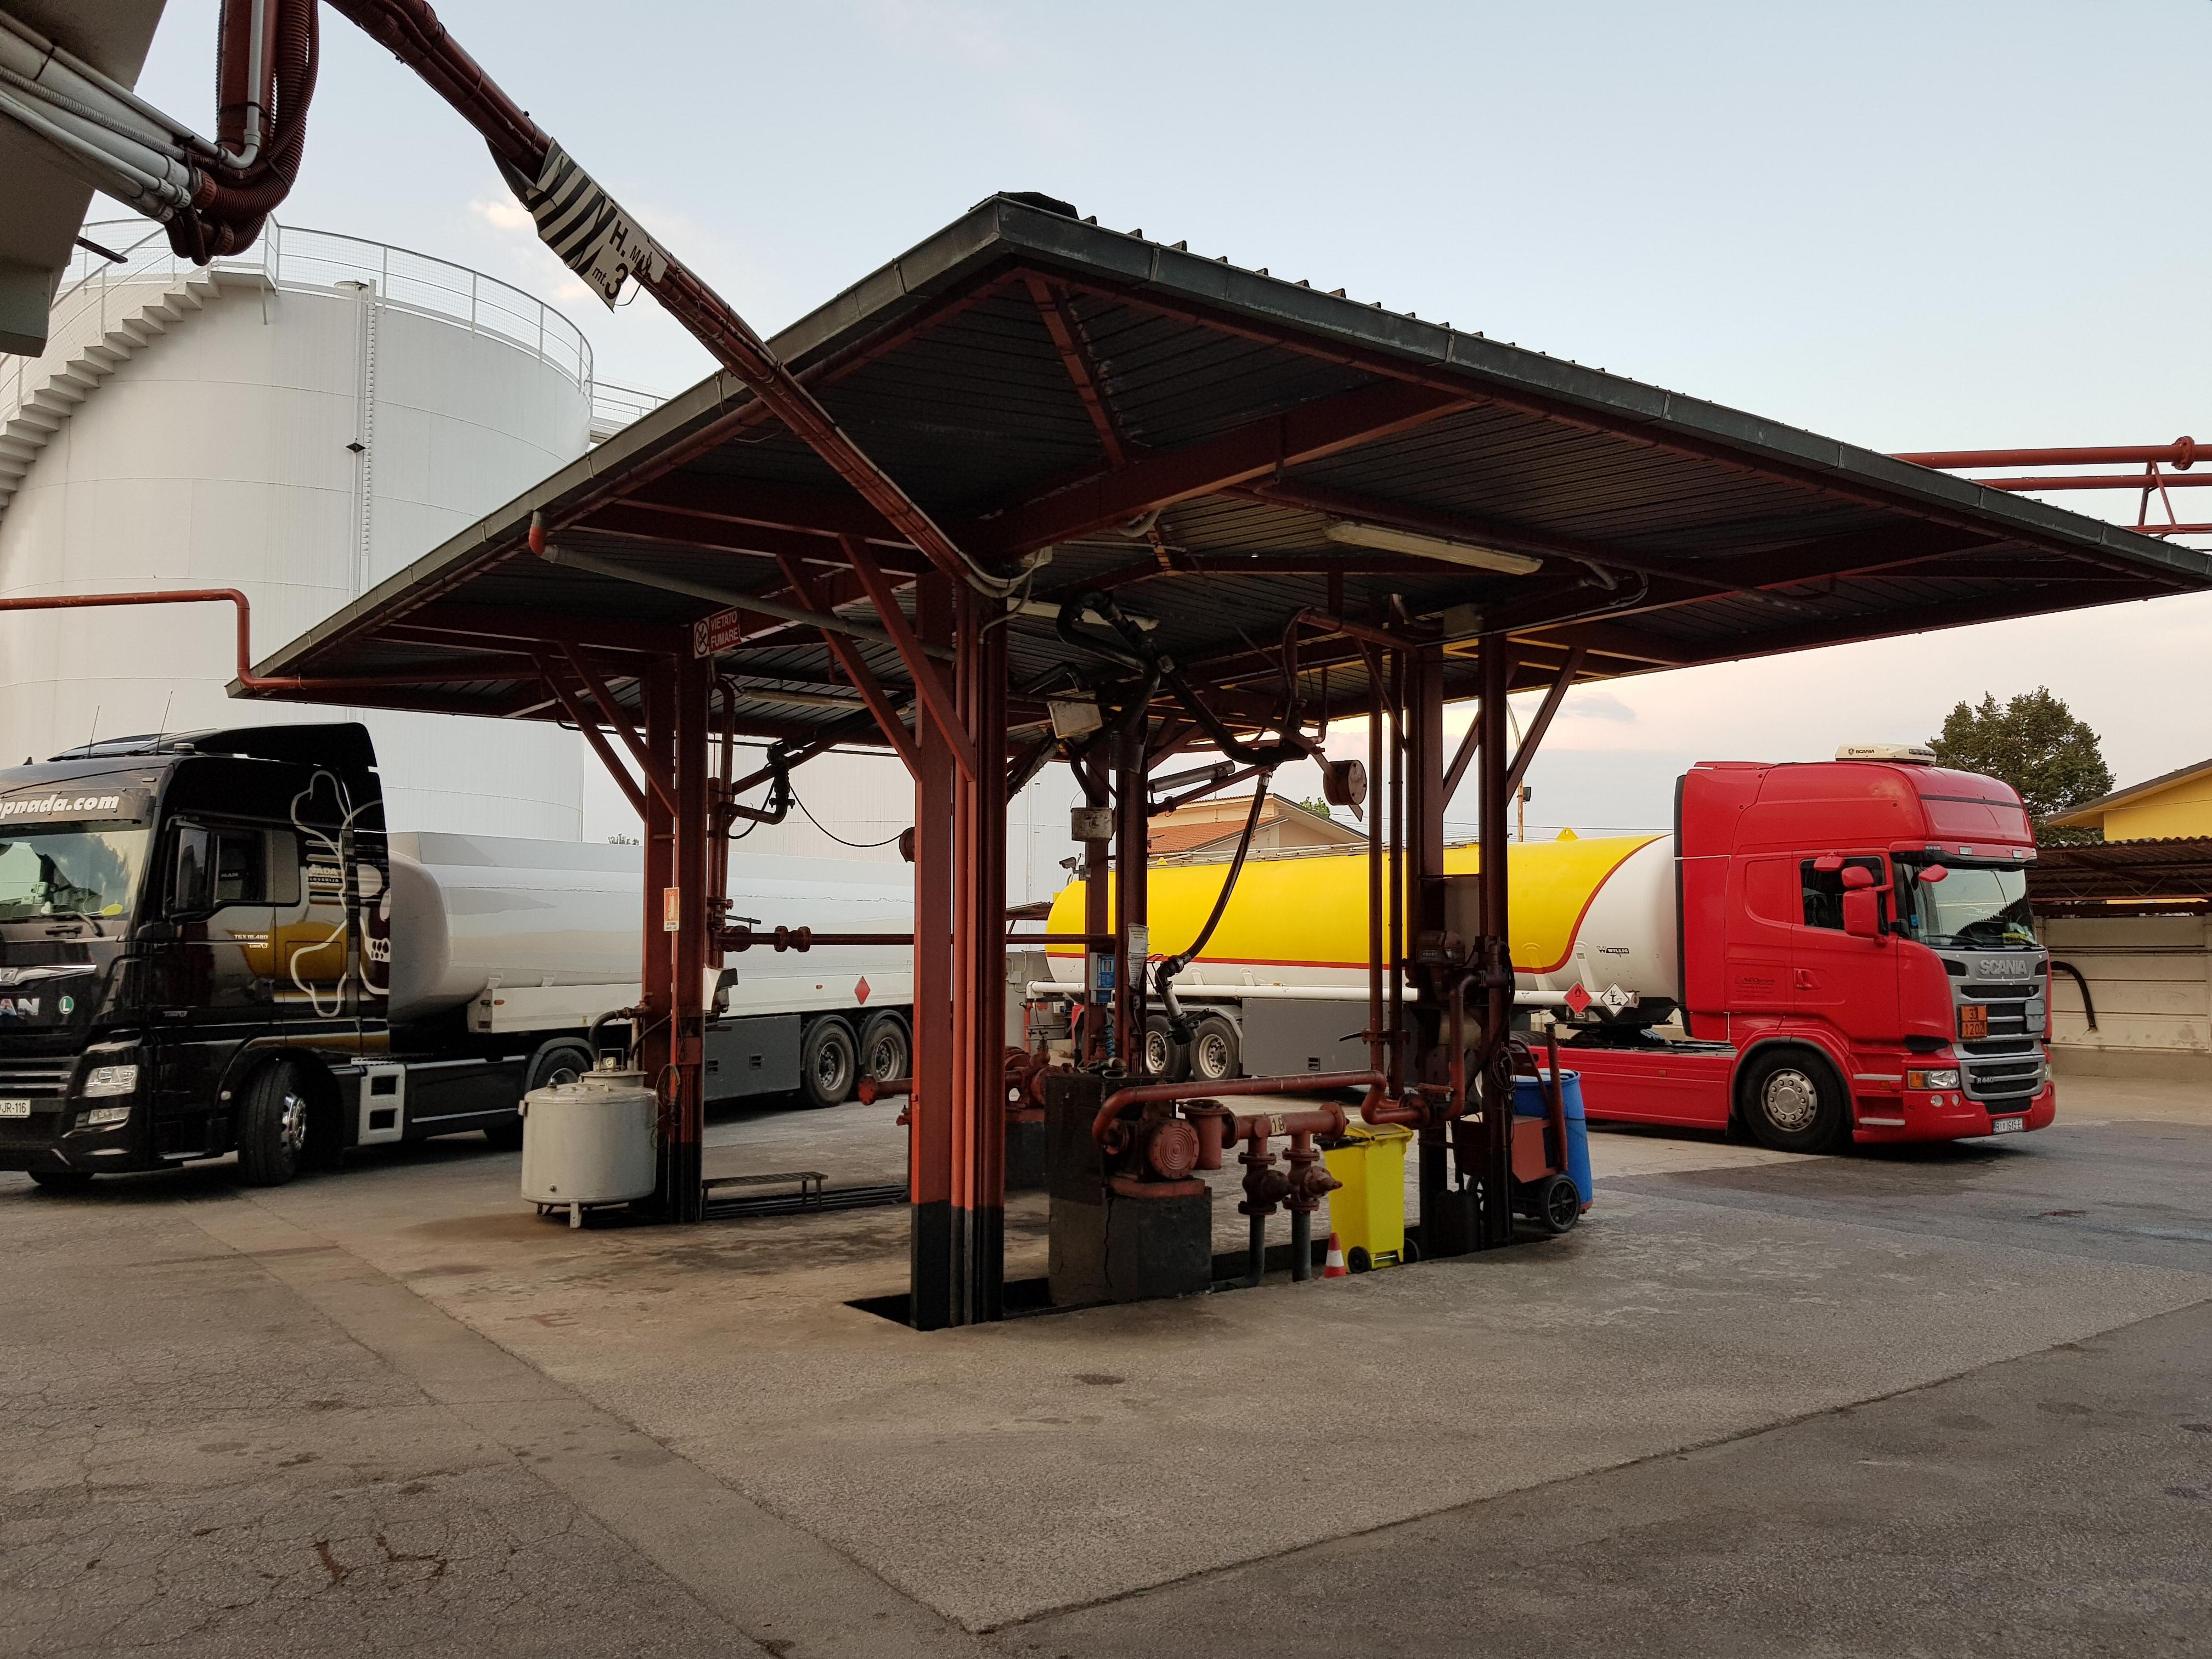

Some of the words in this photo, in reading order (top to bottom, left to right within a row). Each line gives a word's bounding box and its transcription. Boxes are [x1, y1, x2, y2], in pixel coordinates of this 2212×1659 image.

[609, 219, 629, 257] H.
[592, 267, 607, 286] mt.
[605, 263, 628, 300] 3
[710, 611, 737, 631] VIETATO
[710, 627, 739, 648] FUMARE
[0, 794, 120, 819] pnada.com
[1979, 960, 2027, 975] SCANIA
[63, 998, 70, 1012] L
[2, 1102, 26, 1113] JR-116
